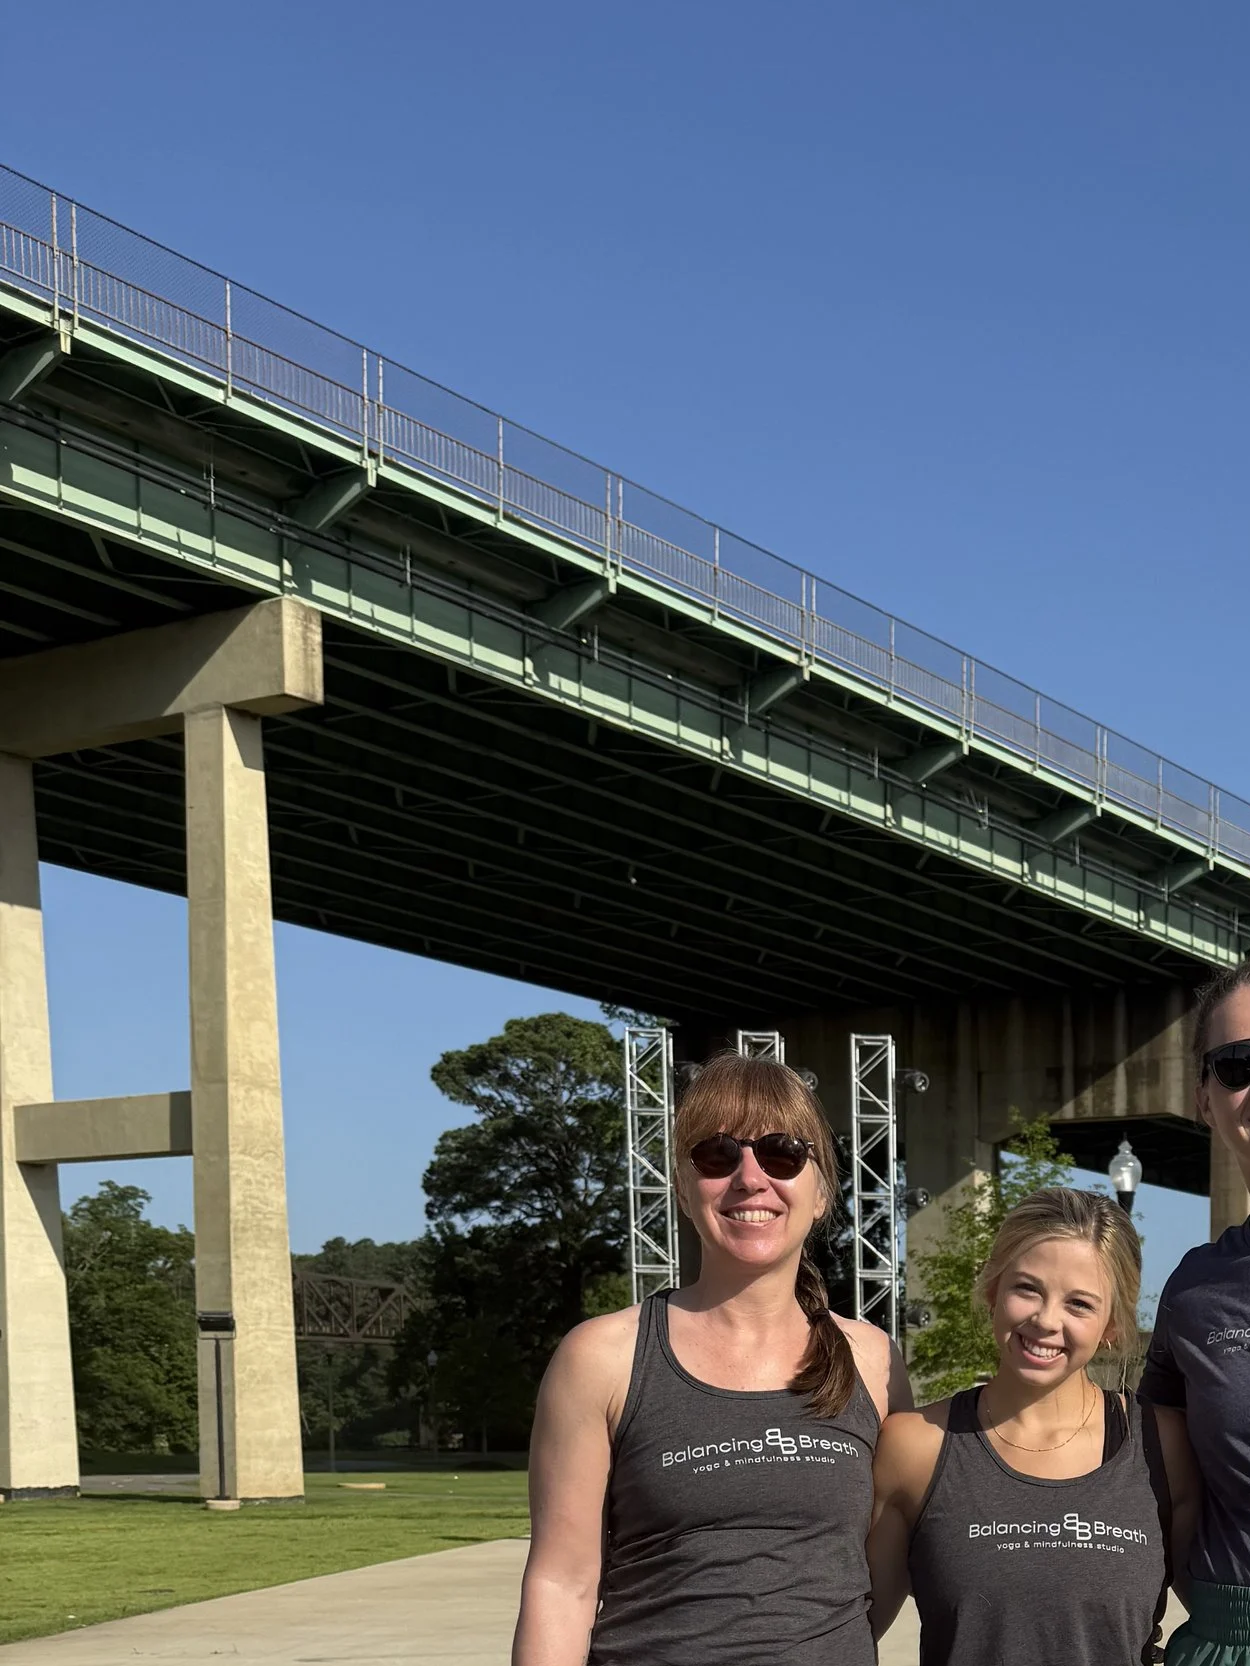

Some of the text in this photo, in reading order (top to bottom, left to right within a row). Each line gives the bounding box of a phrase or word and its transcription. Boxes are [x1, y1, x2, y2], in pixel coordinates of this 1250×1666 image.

[661, 1437, 763, 1467] Balancing
[799, 1434, 859, 1457] Breath
[693, 1455, 836, 1474] yoga & mindfulness studio
[968, 1520, 1061, 1539] Balancing
[1094, 1520, 1148, 1546] Breath
[997, 1540, 1125, 1554] yoga & mindfulness studio
